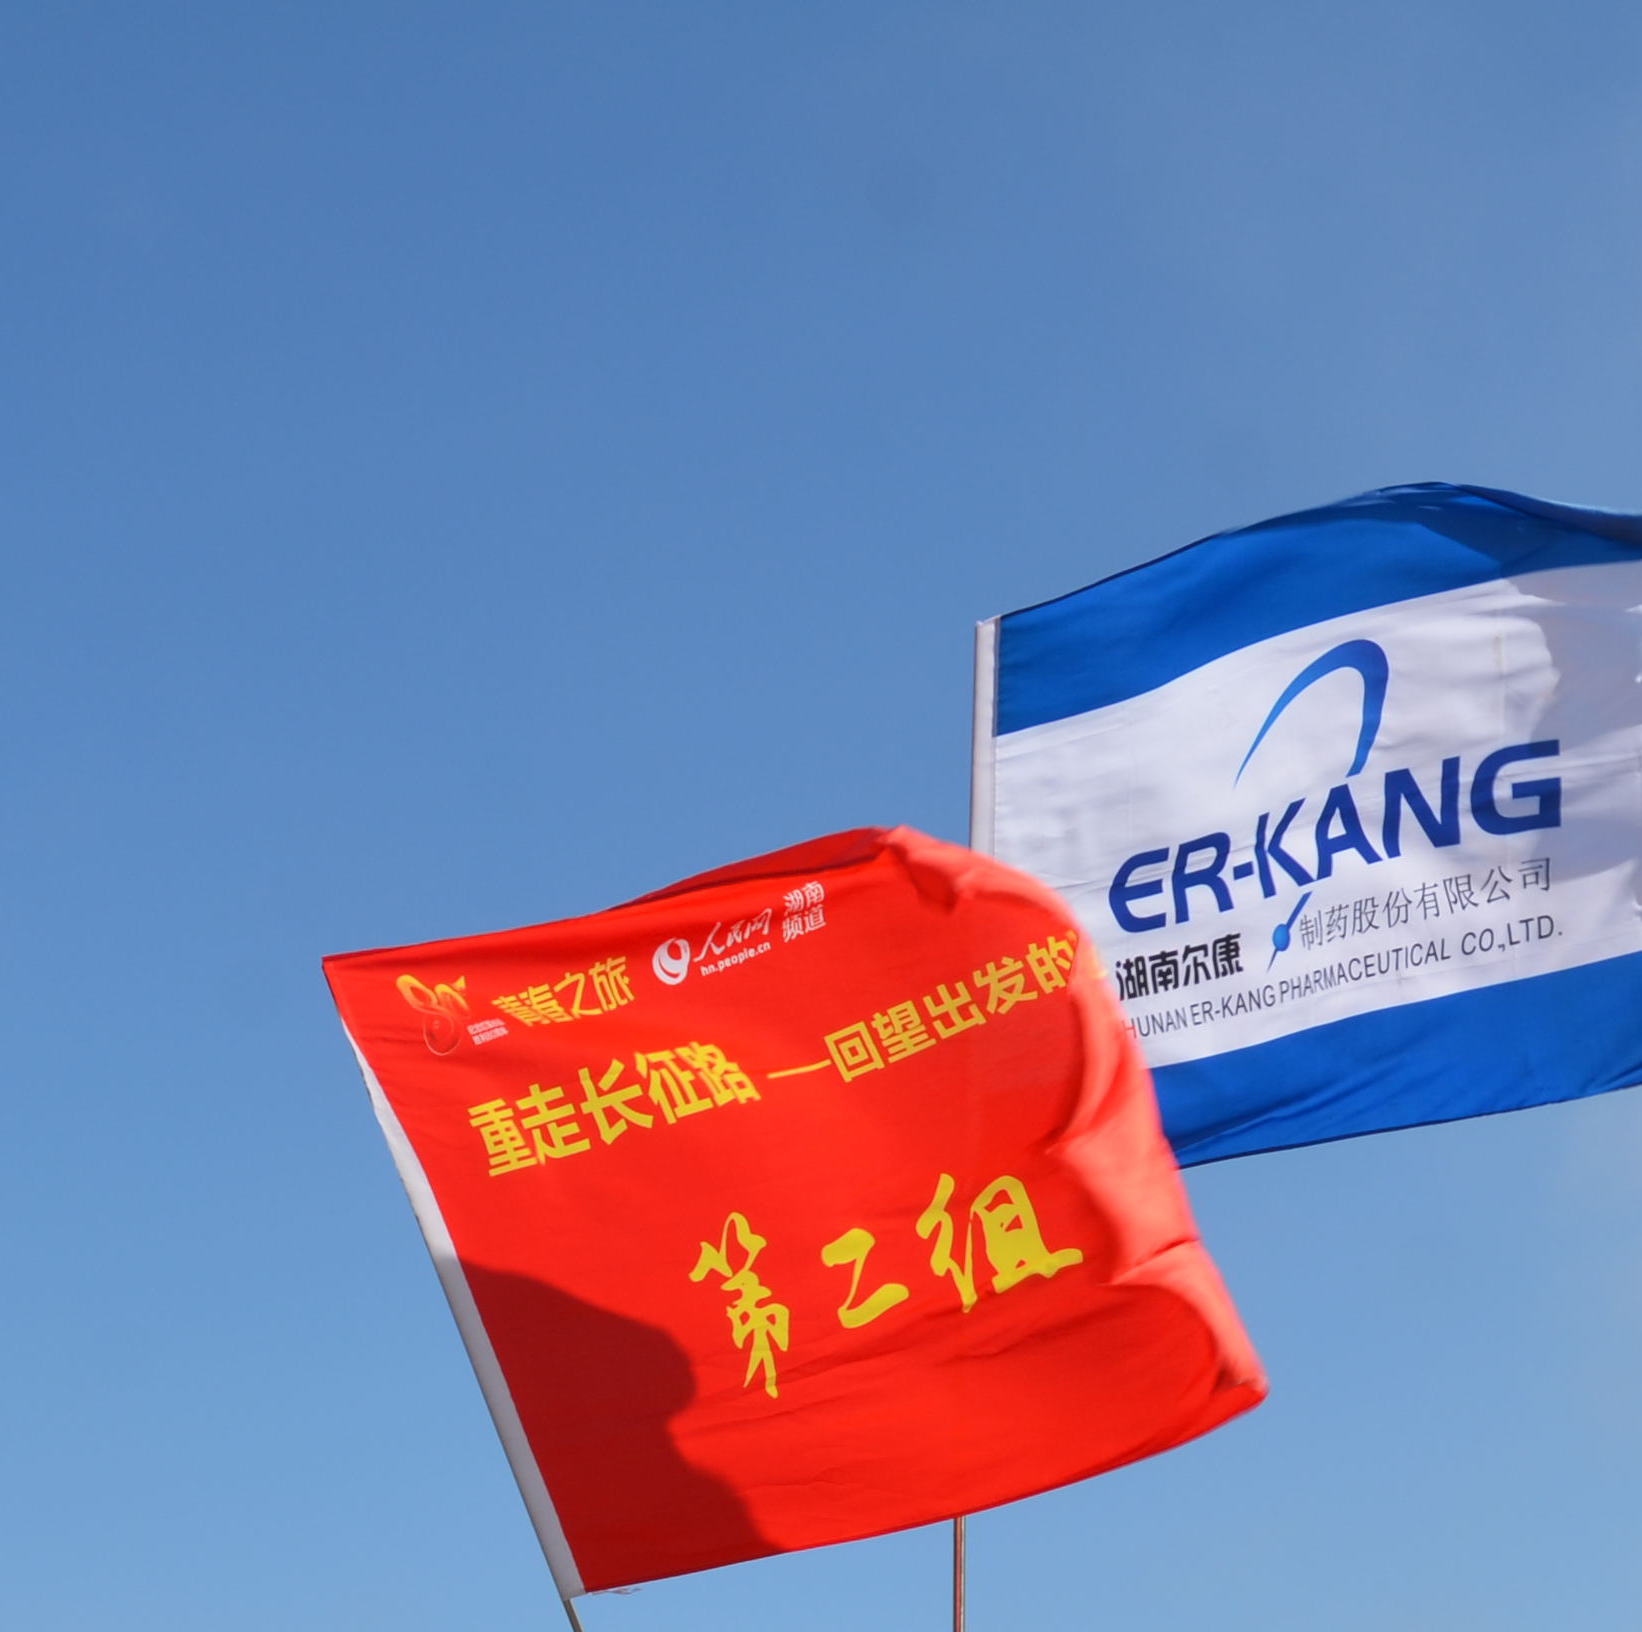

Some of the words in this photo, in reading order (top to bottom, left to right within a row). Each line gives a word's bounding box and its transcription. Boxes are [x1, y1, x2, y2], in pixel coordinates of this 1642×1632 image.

[1108, 739, 1562, 934] ER-KANG
[693, 908, 773, 962] 人民网
[782, 881, 824, 916] 湖南
[782, 904, 826, 943] 频道
[1115, 932, 1244, 1002] 湖南尔康
[1299, 857, 1551, 950] 制药股份有限公司
[700, 941, 772, 977] hn.people.cn
[1123, 1007, 1188, 1039] HUNAN
[1189, 984, 1276, 1027] ER-KANG
[1279, 938, 1452, 1004] PHARMACEUTICAL
[469, 1041, 761, 1177] 重走长征路
[689, 1173, 1083, 1399] 第二组
